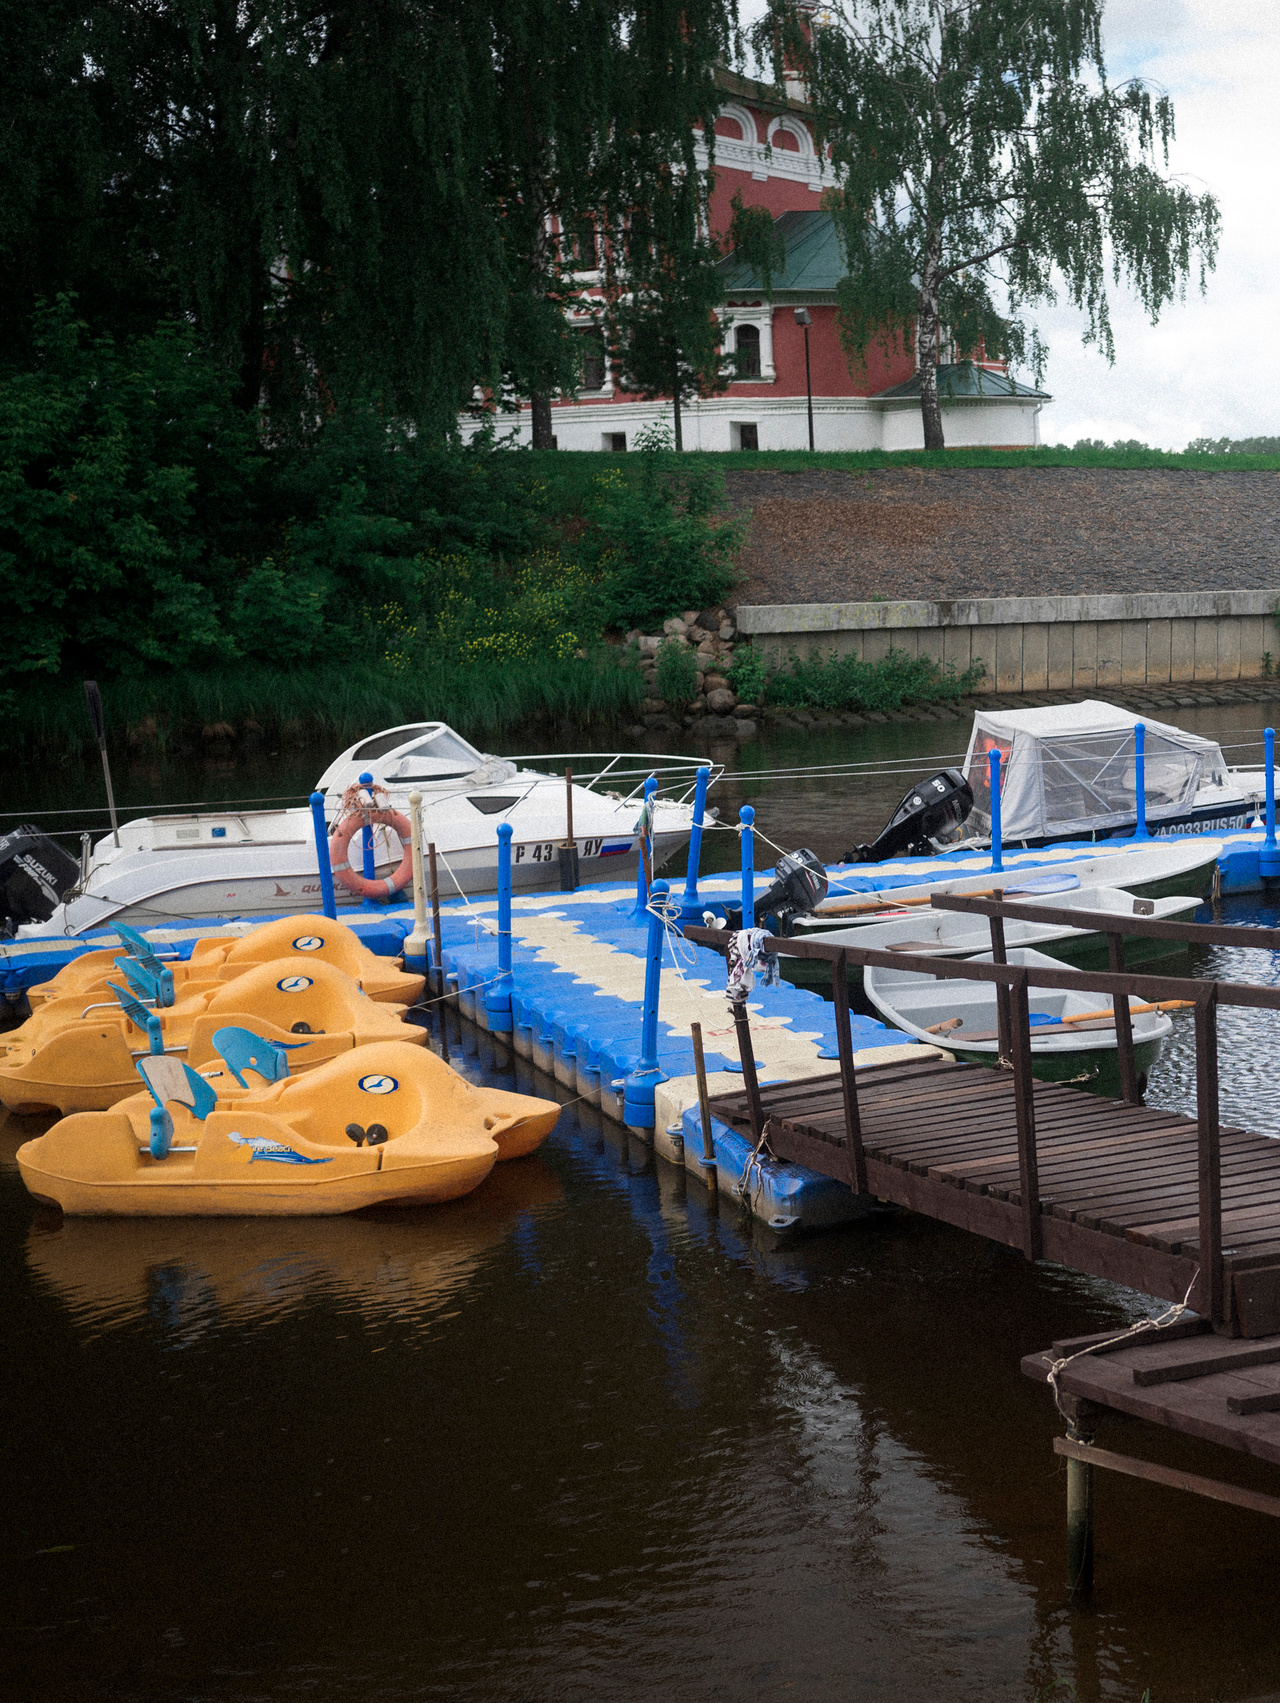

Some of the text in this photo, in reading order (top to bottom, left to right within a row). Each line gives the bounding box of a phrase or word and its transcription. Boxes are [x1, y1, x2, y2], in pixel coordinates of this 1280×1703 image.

[931, 779, 946, 793] 50
[532, 843, 553, 862] 43
[22, 854, 58, 885] SUZUKI
